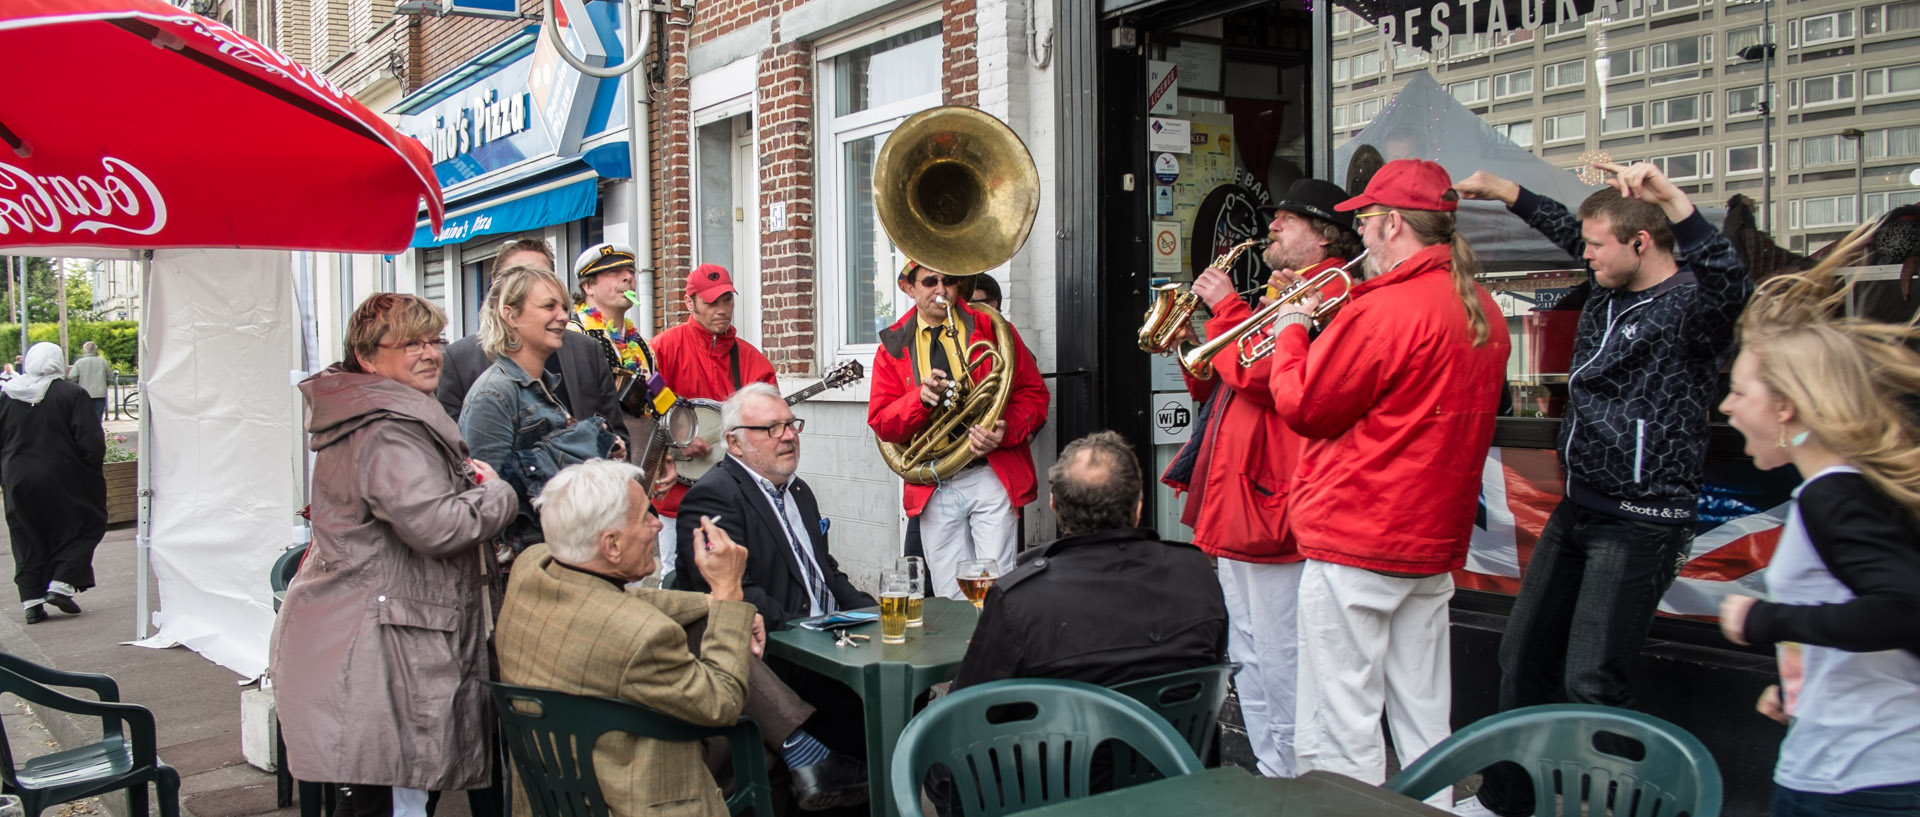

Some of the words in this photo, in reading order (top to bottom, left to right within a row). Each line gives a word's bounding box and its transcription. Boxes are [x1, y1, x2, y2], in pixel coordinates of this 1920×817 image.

[1378, 0, 1657, 62] RESTAUR
[1150, 69, 1176, 106] LICENCE
[411, 107, 469, 166] mino's
[473, 87, 526, 148] Pizza
[1191, 135, 1207, 144] KER
[1245, 172, 1270, 205] BAR
[470, 214, 493, 235] Pizza
[772, 206, 783, 228] 54
[1619, 500, 1659, 517] Scott
[1660, 507, 1672, 518] &
